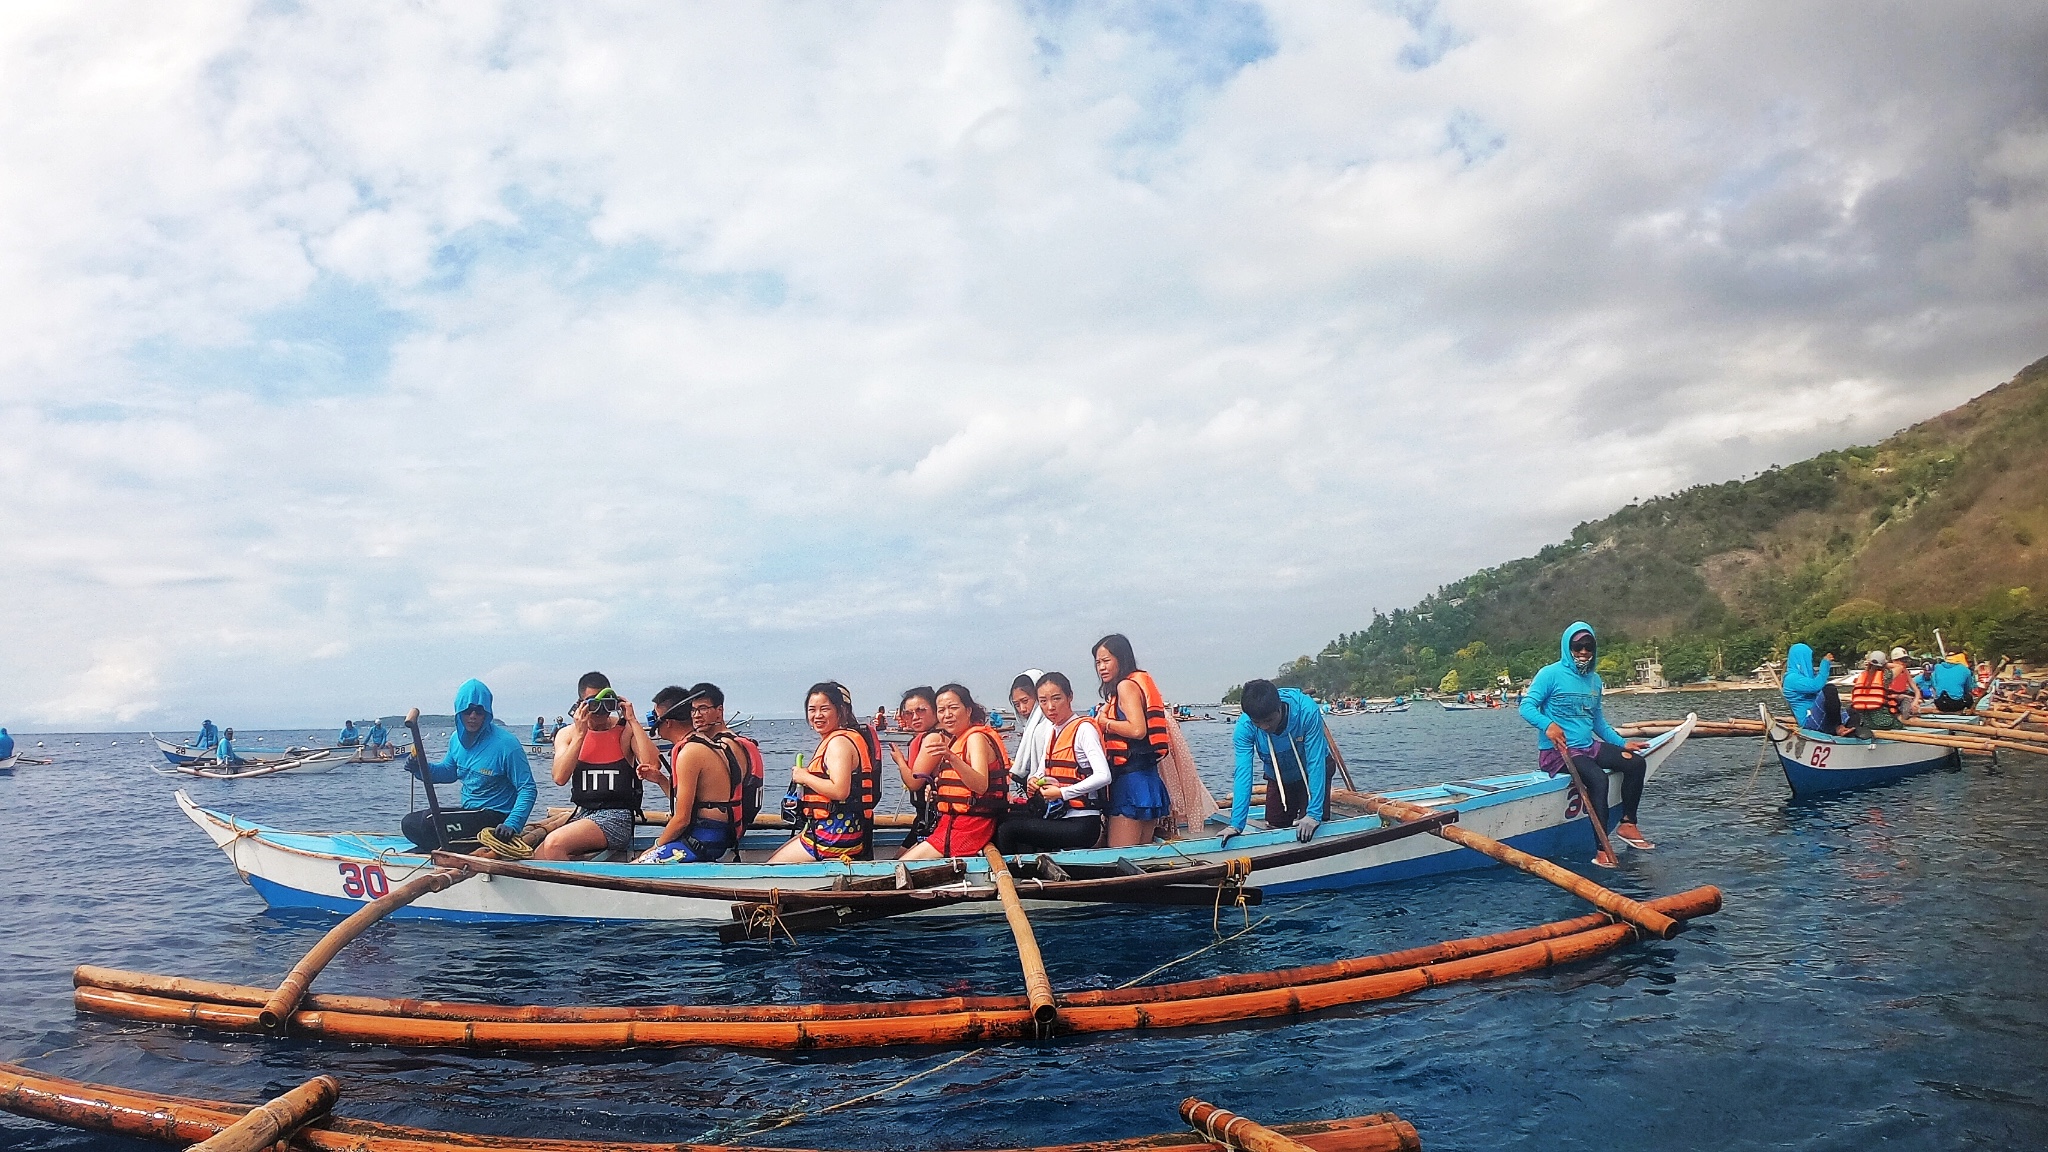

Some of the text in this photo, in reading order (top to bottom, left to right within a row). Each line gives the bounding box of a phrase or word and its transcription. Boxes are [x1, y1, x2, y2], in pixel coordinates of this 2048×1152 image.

[1810, 745, 1831, 768] 62
[581, 769, 620, 791] ITT
[338, 862, 390, 900] 30
